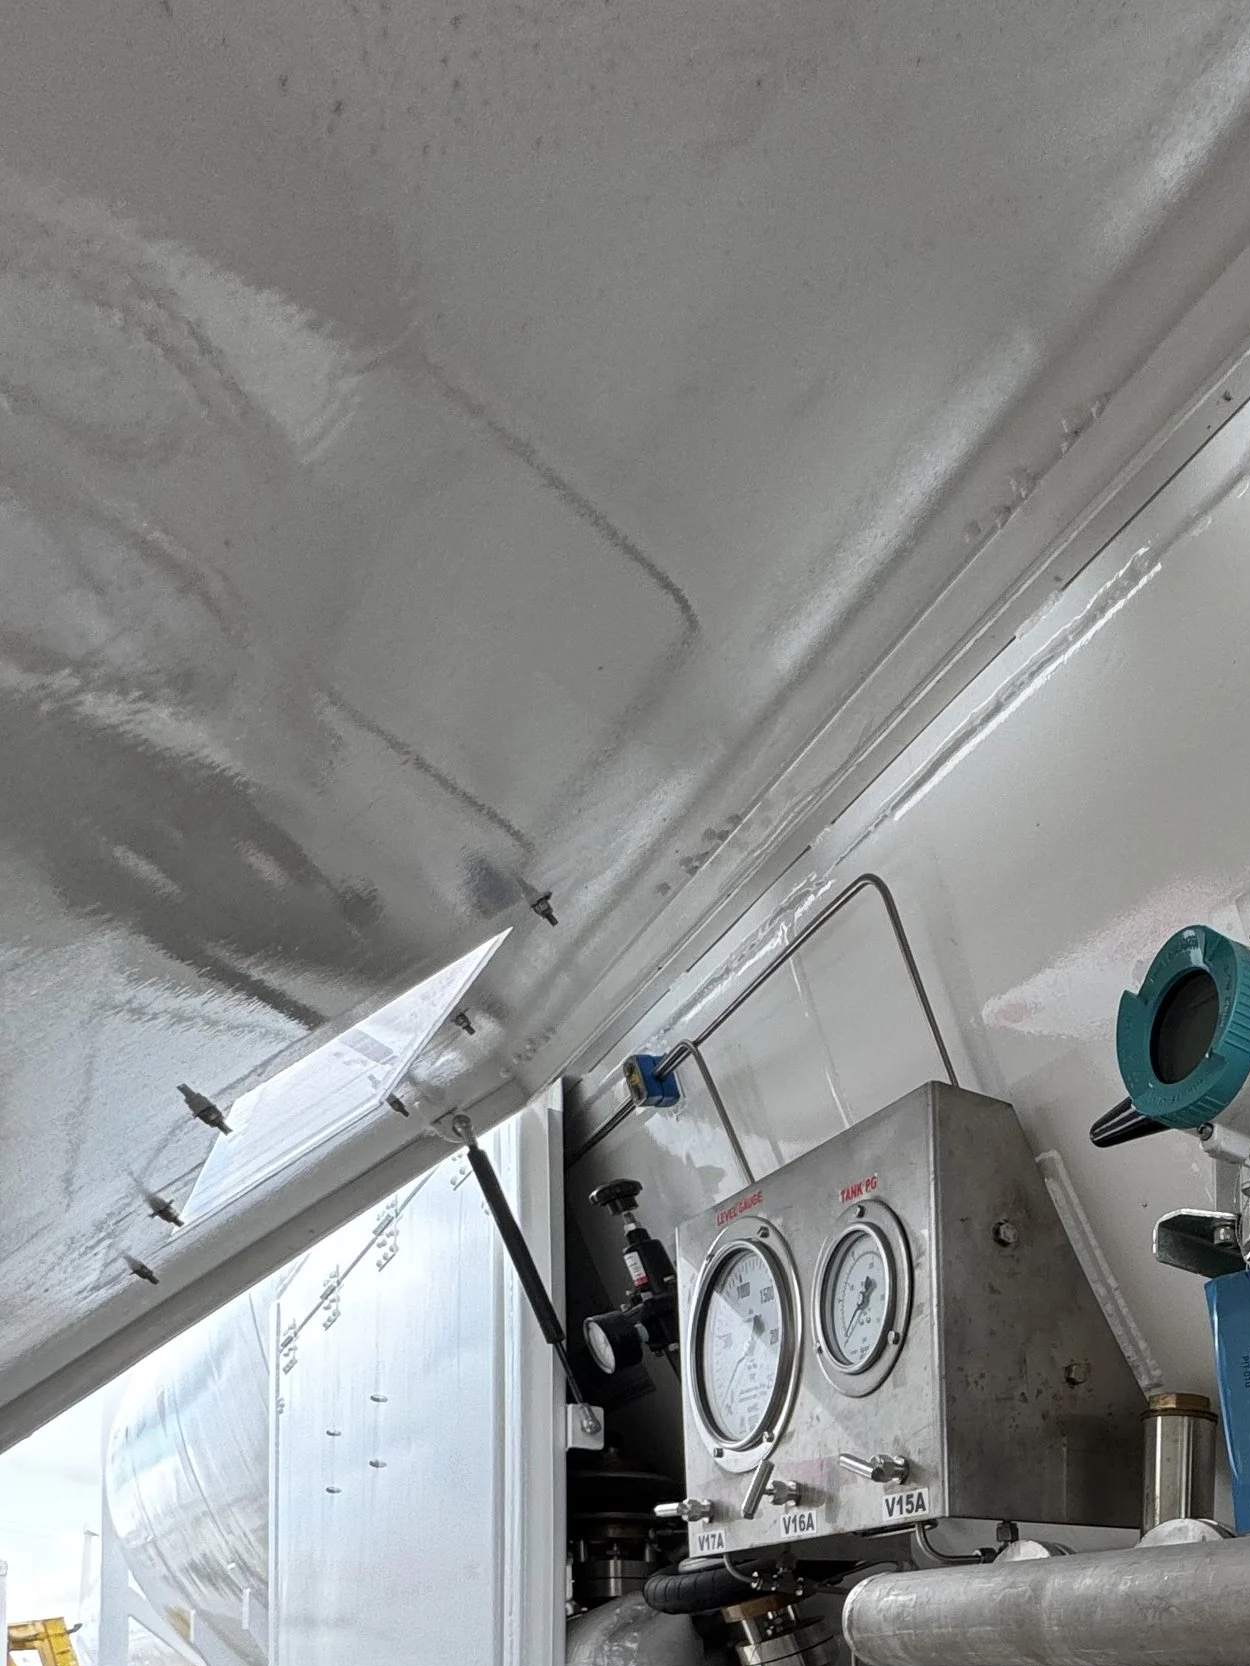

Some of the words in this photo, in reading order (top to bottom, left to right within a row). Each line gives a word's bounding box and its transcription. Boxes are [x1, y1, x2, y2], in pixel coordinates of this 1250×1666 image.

[840, 1180, 863, 1204] TANK
[716, 1206, 737, 1227] LEVEL
[738, 1190, 763, 1215] GAUGE
[885, 1492, 927, 1518] V15A
[782, 1512, 815, 1535] V16A
[698, 1534, 724, 1551] V17A
